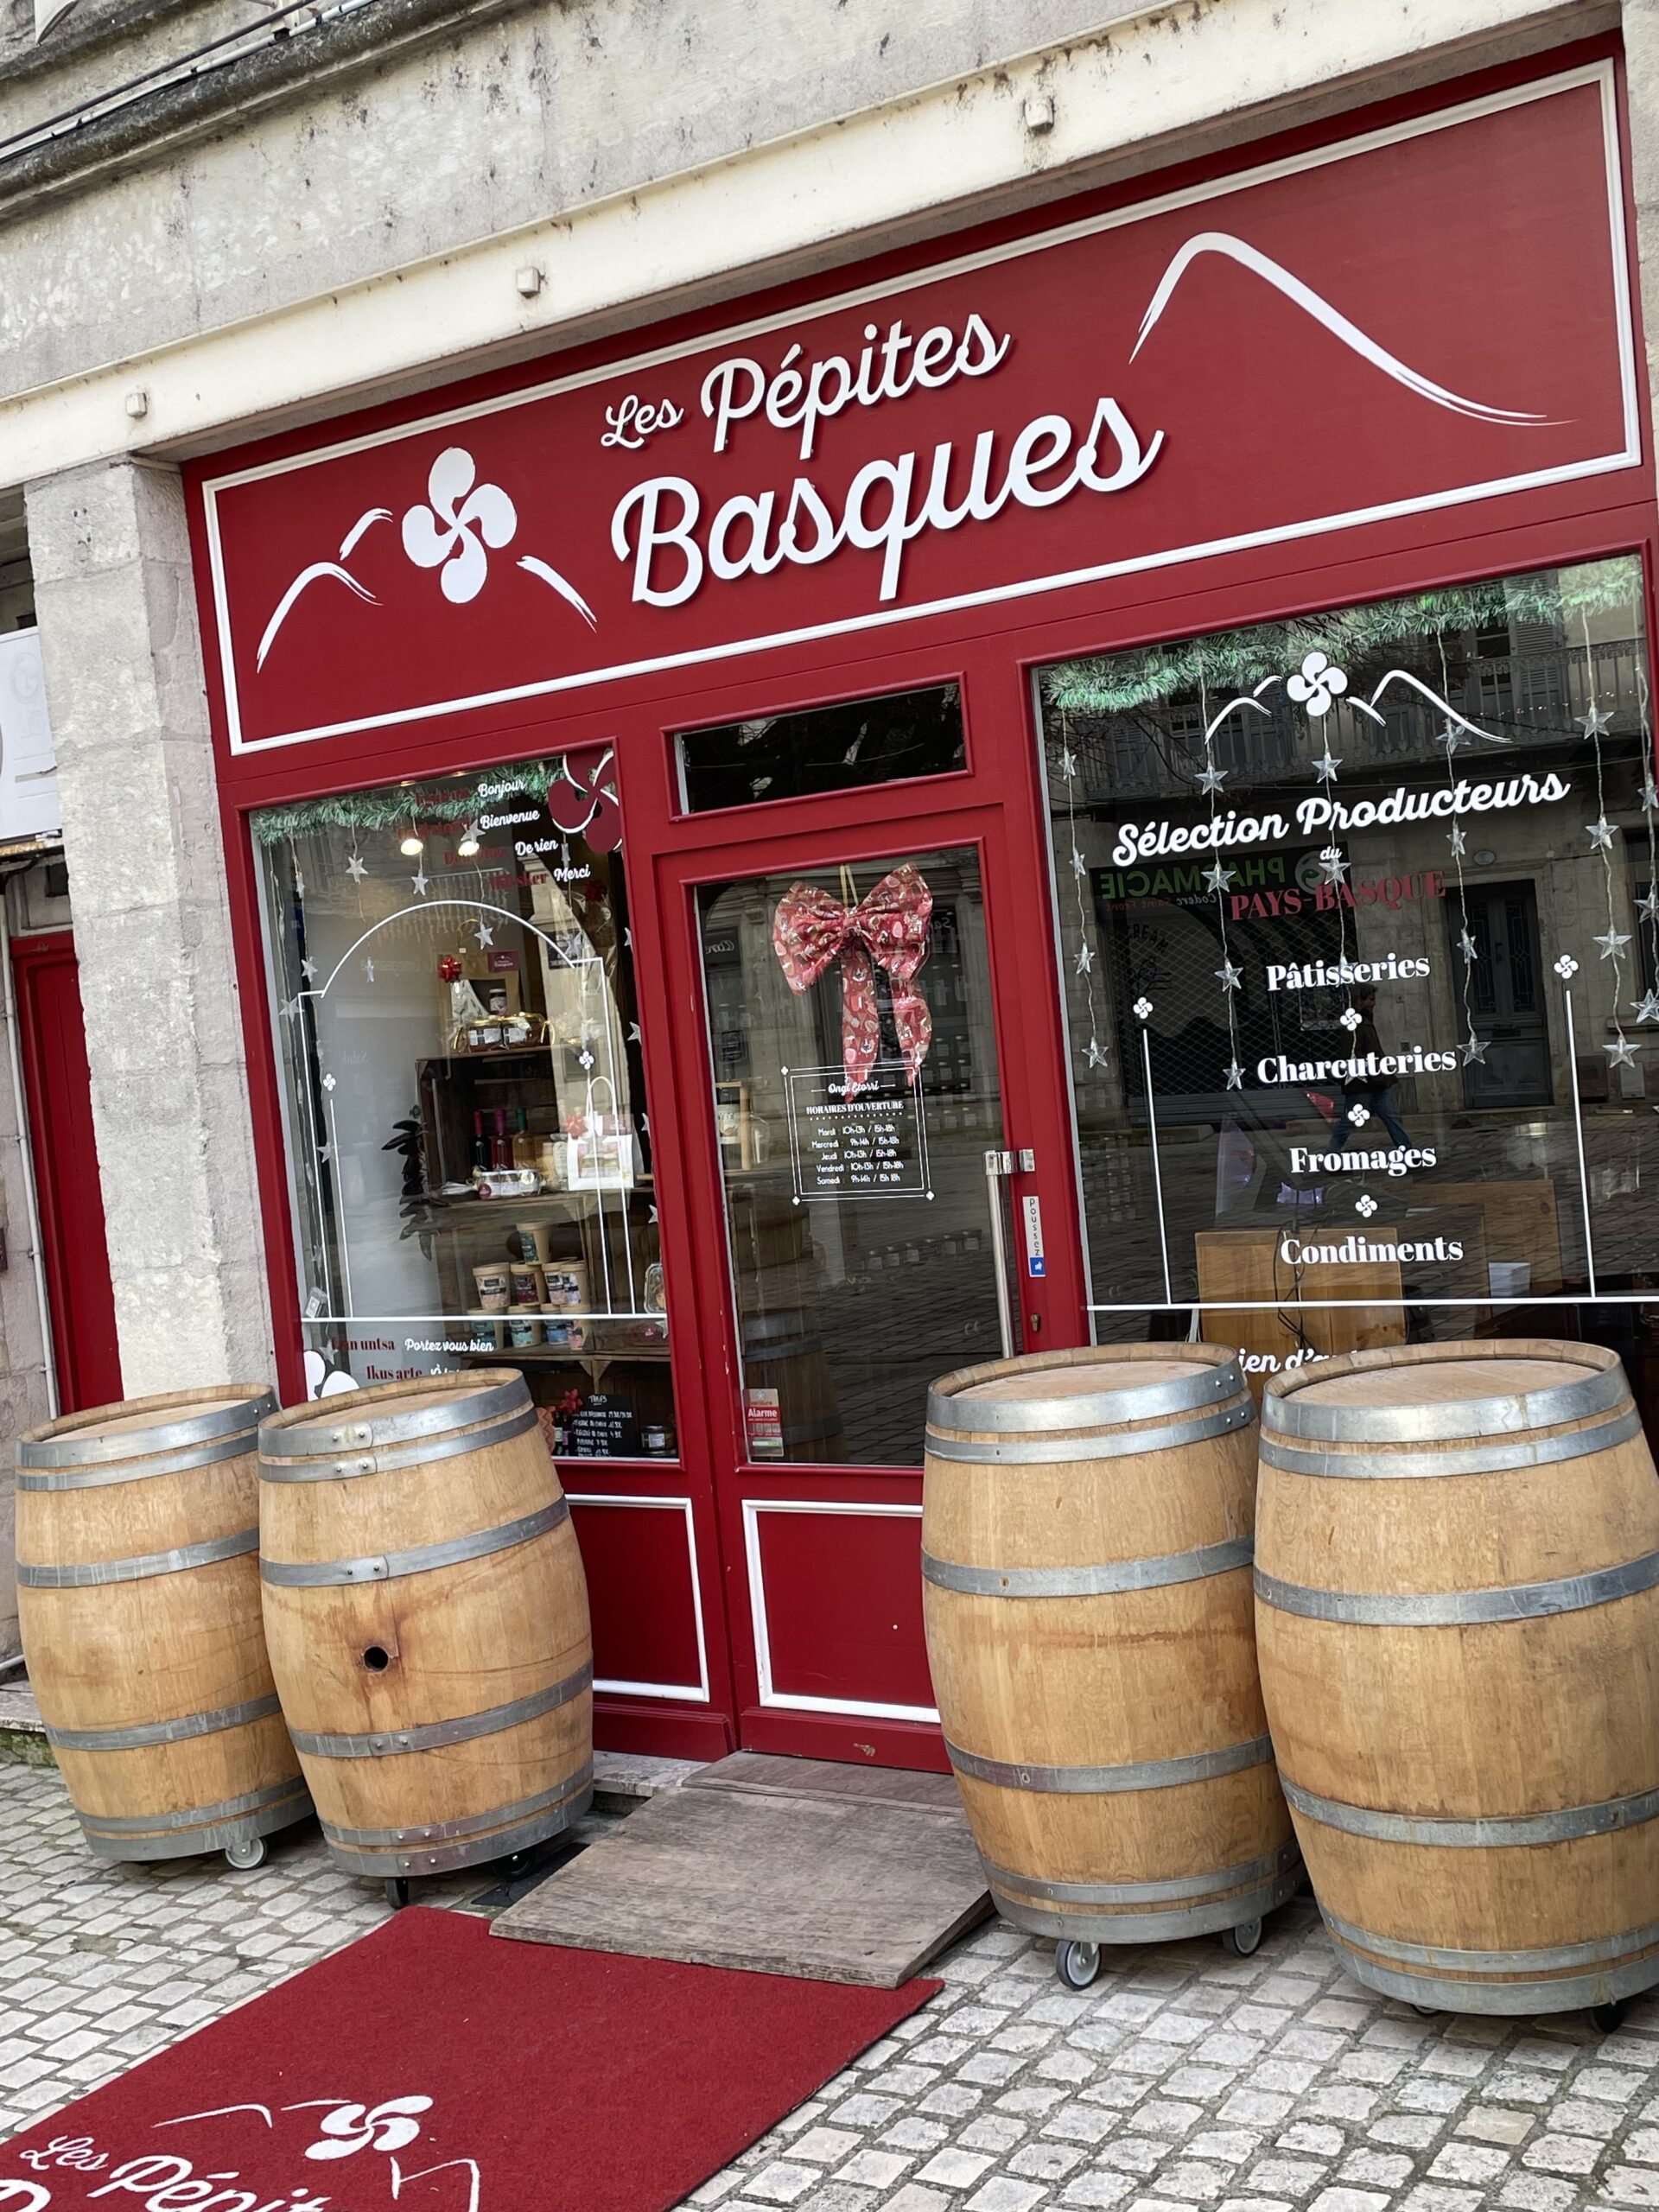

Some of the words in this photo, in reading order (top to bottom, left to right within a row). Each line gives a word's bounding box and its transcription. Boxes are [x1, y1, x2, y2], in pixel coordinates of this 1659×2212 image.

[601, 394, 684, 448] Les
[701, 314, 1011, 460] Pépites
[610, 397, 1165, 607] Basques
[478, 779, 528, 799] Bonjour
[480, 810, 540, 830] Bienvenue
[1112, 810, 1289, 868] Sélection
[1297, 772, 1572, 835] Producteurs
[515, 841, 534, 856] De
[535, 838, 559, 852] rien
[1319, 843, 1342, 861] du
[554, 864, 591, 882] Merci
[1230, 871, 1447, 922] PAYS-BASQUE
[1266, 952, 1431, 991] Pâtisseries
[1257, 1045, 1457, 1084] Charcuteries
[817, 1127, 836, 1136] Mardi
[811, 1140, 840, 1149] Mercredi
[821, 1152, 837, 1161] Jeudi
[1289, 1145, 1437, 1177] Fromages
[816, 1164, 844, 1173] Vendredi
[817, 1176, 840, 1185] Samedi
[1281, 1236, 1464, 1265] Condiments
[360, 1337, 395, 1351] untsa
[404, 1338, 443, 1353] Portez
[442, 1341, 469, 1352] vous
[469, 1338, 493, 1352] bien
[367, 1365, 393, 1380] Ikus
[748, 1408, 778, 1418] Alarme
[19, 2135, 109, 2171] Les
